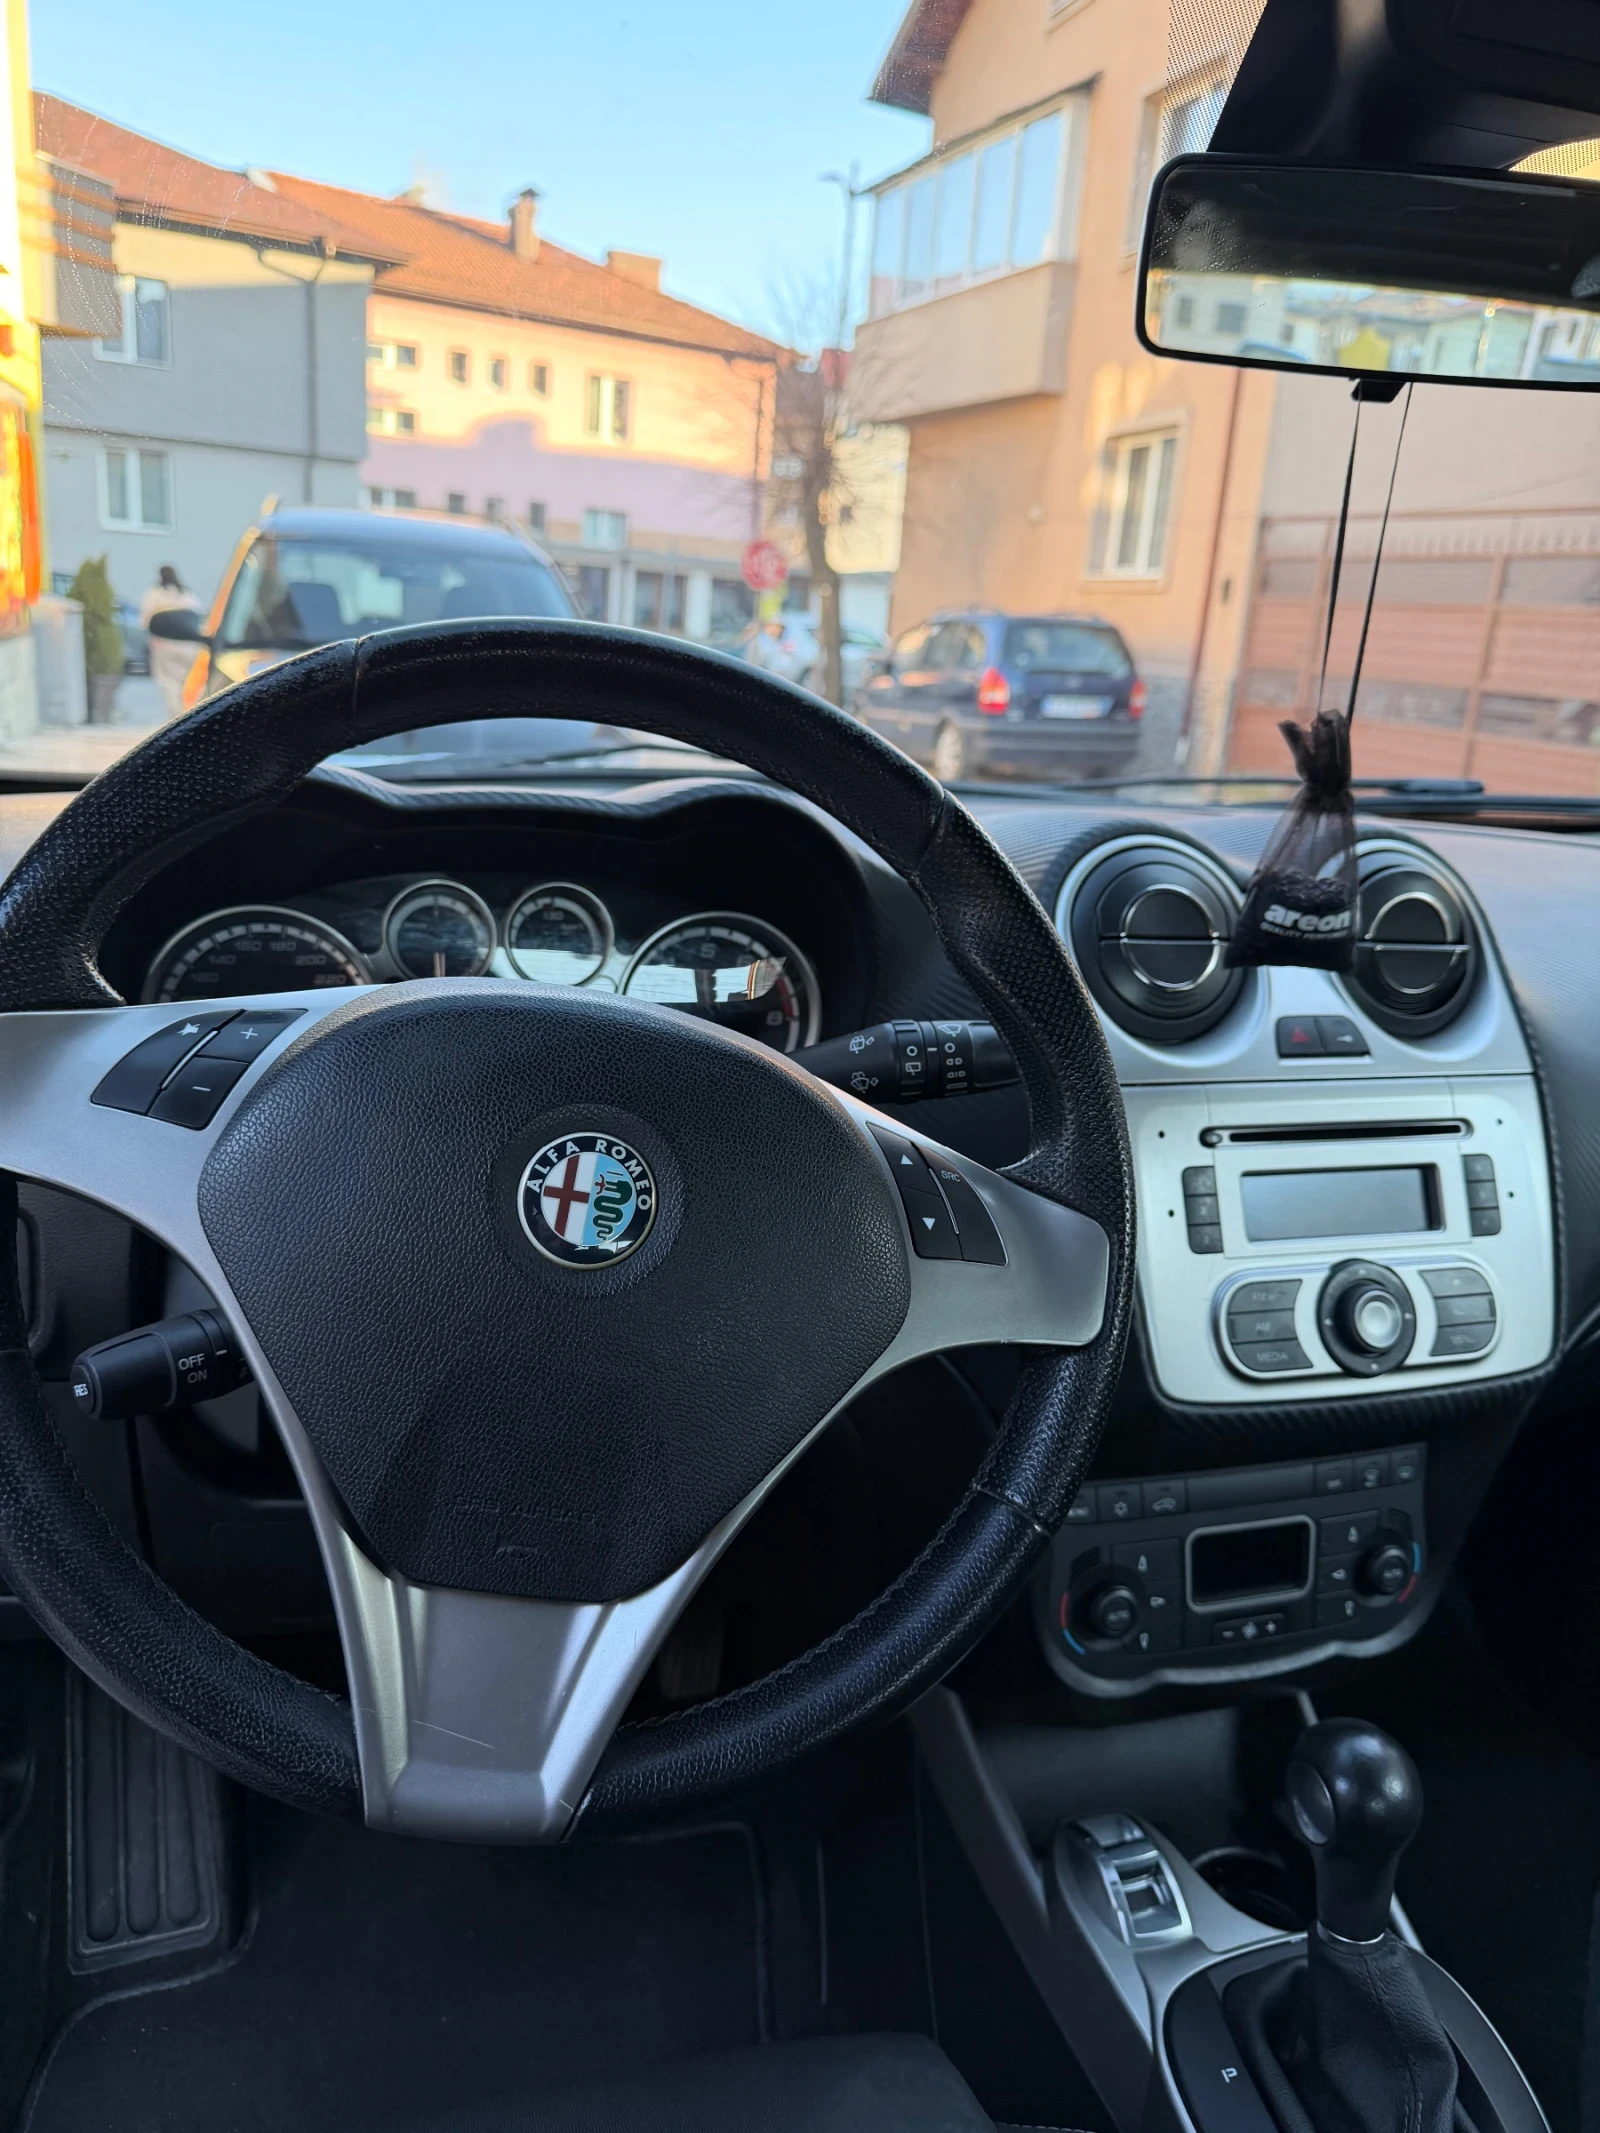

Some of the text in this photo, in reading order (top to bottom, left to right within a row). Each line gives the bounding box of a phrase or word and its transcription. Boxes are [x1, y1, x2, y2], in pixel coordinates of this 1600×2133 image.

[1263, 903, 1351, 932] areon
[527, 1139, 652, 1211] ALFA ROMEO
[940, 1169, 961, 1182] SRC
[178, 1353, 206, 1371] OFF
[187, 1369, 208, 1384] ON
[74, 1383, 88, 1397] RES
